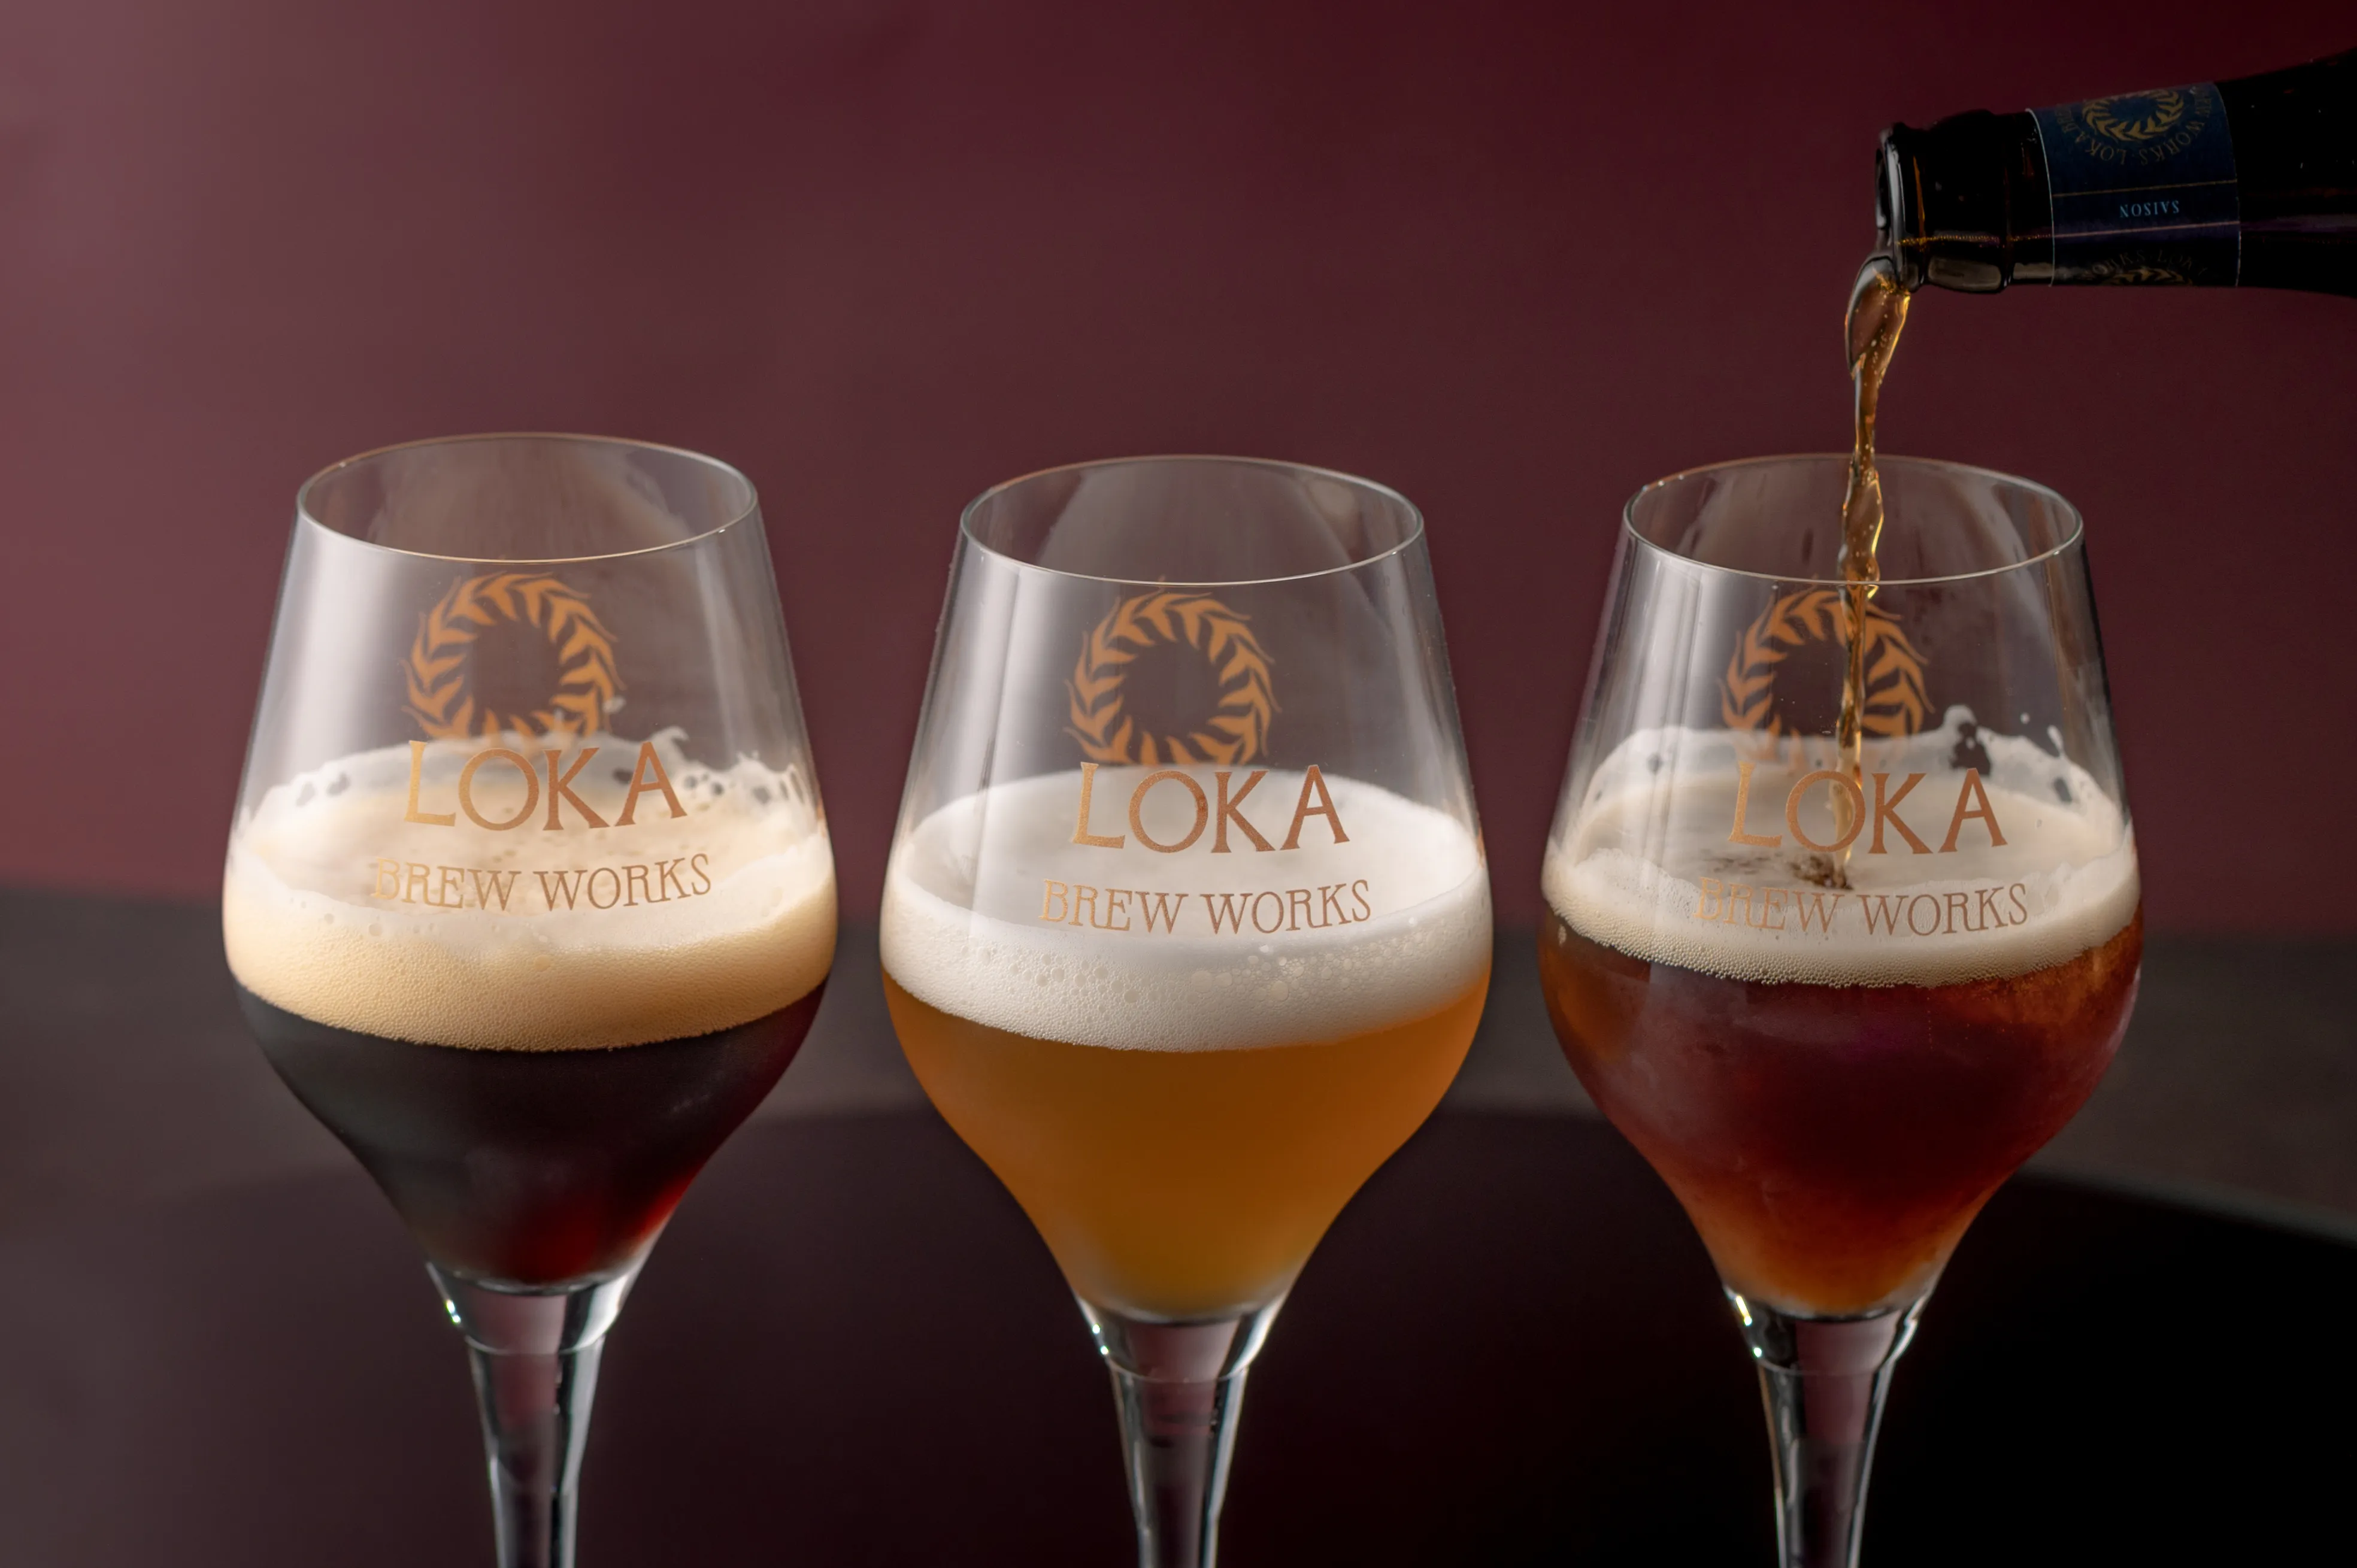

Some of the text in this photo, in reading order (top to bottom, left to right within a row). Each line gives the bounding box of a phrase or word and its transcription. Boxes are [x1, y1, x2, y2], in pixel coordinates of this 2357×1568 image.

[2074, 131, 2126, 166] LOKA
[2139, 120, 2205, 166] WORKS
[2119, 200, 2180, 219] SAISON
[2083, 248, 2146, 278] ORKS
[404, 740, 687, 831] LOKA
[1071, 762, 1350, 854] LOKA
[1728, 760, 2008, 854] LOKA
[370, 853, 711, 911] BREW WORKS
[1039, 878, 1371, 935] BREW WORKS
[1693, 876, 2028, 936] BREW WORKS
